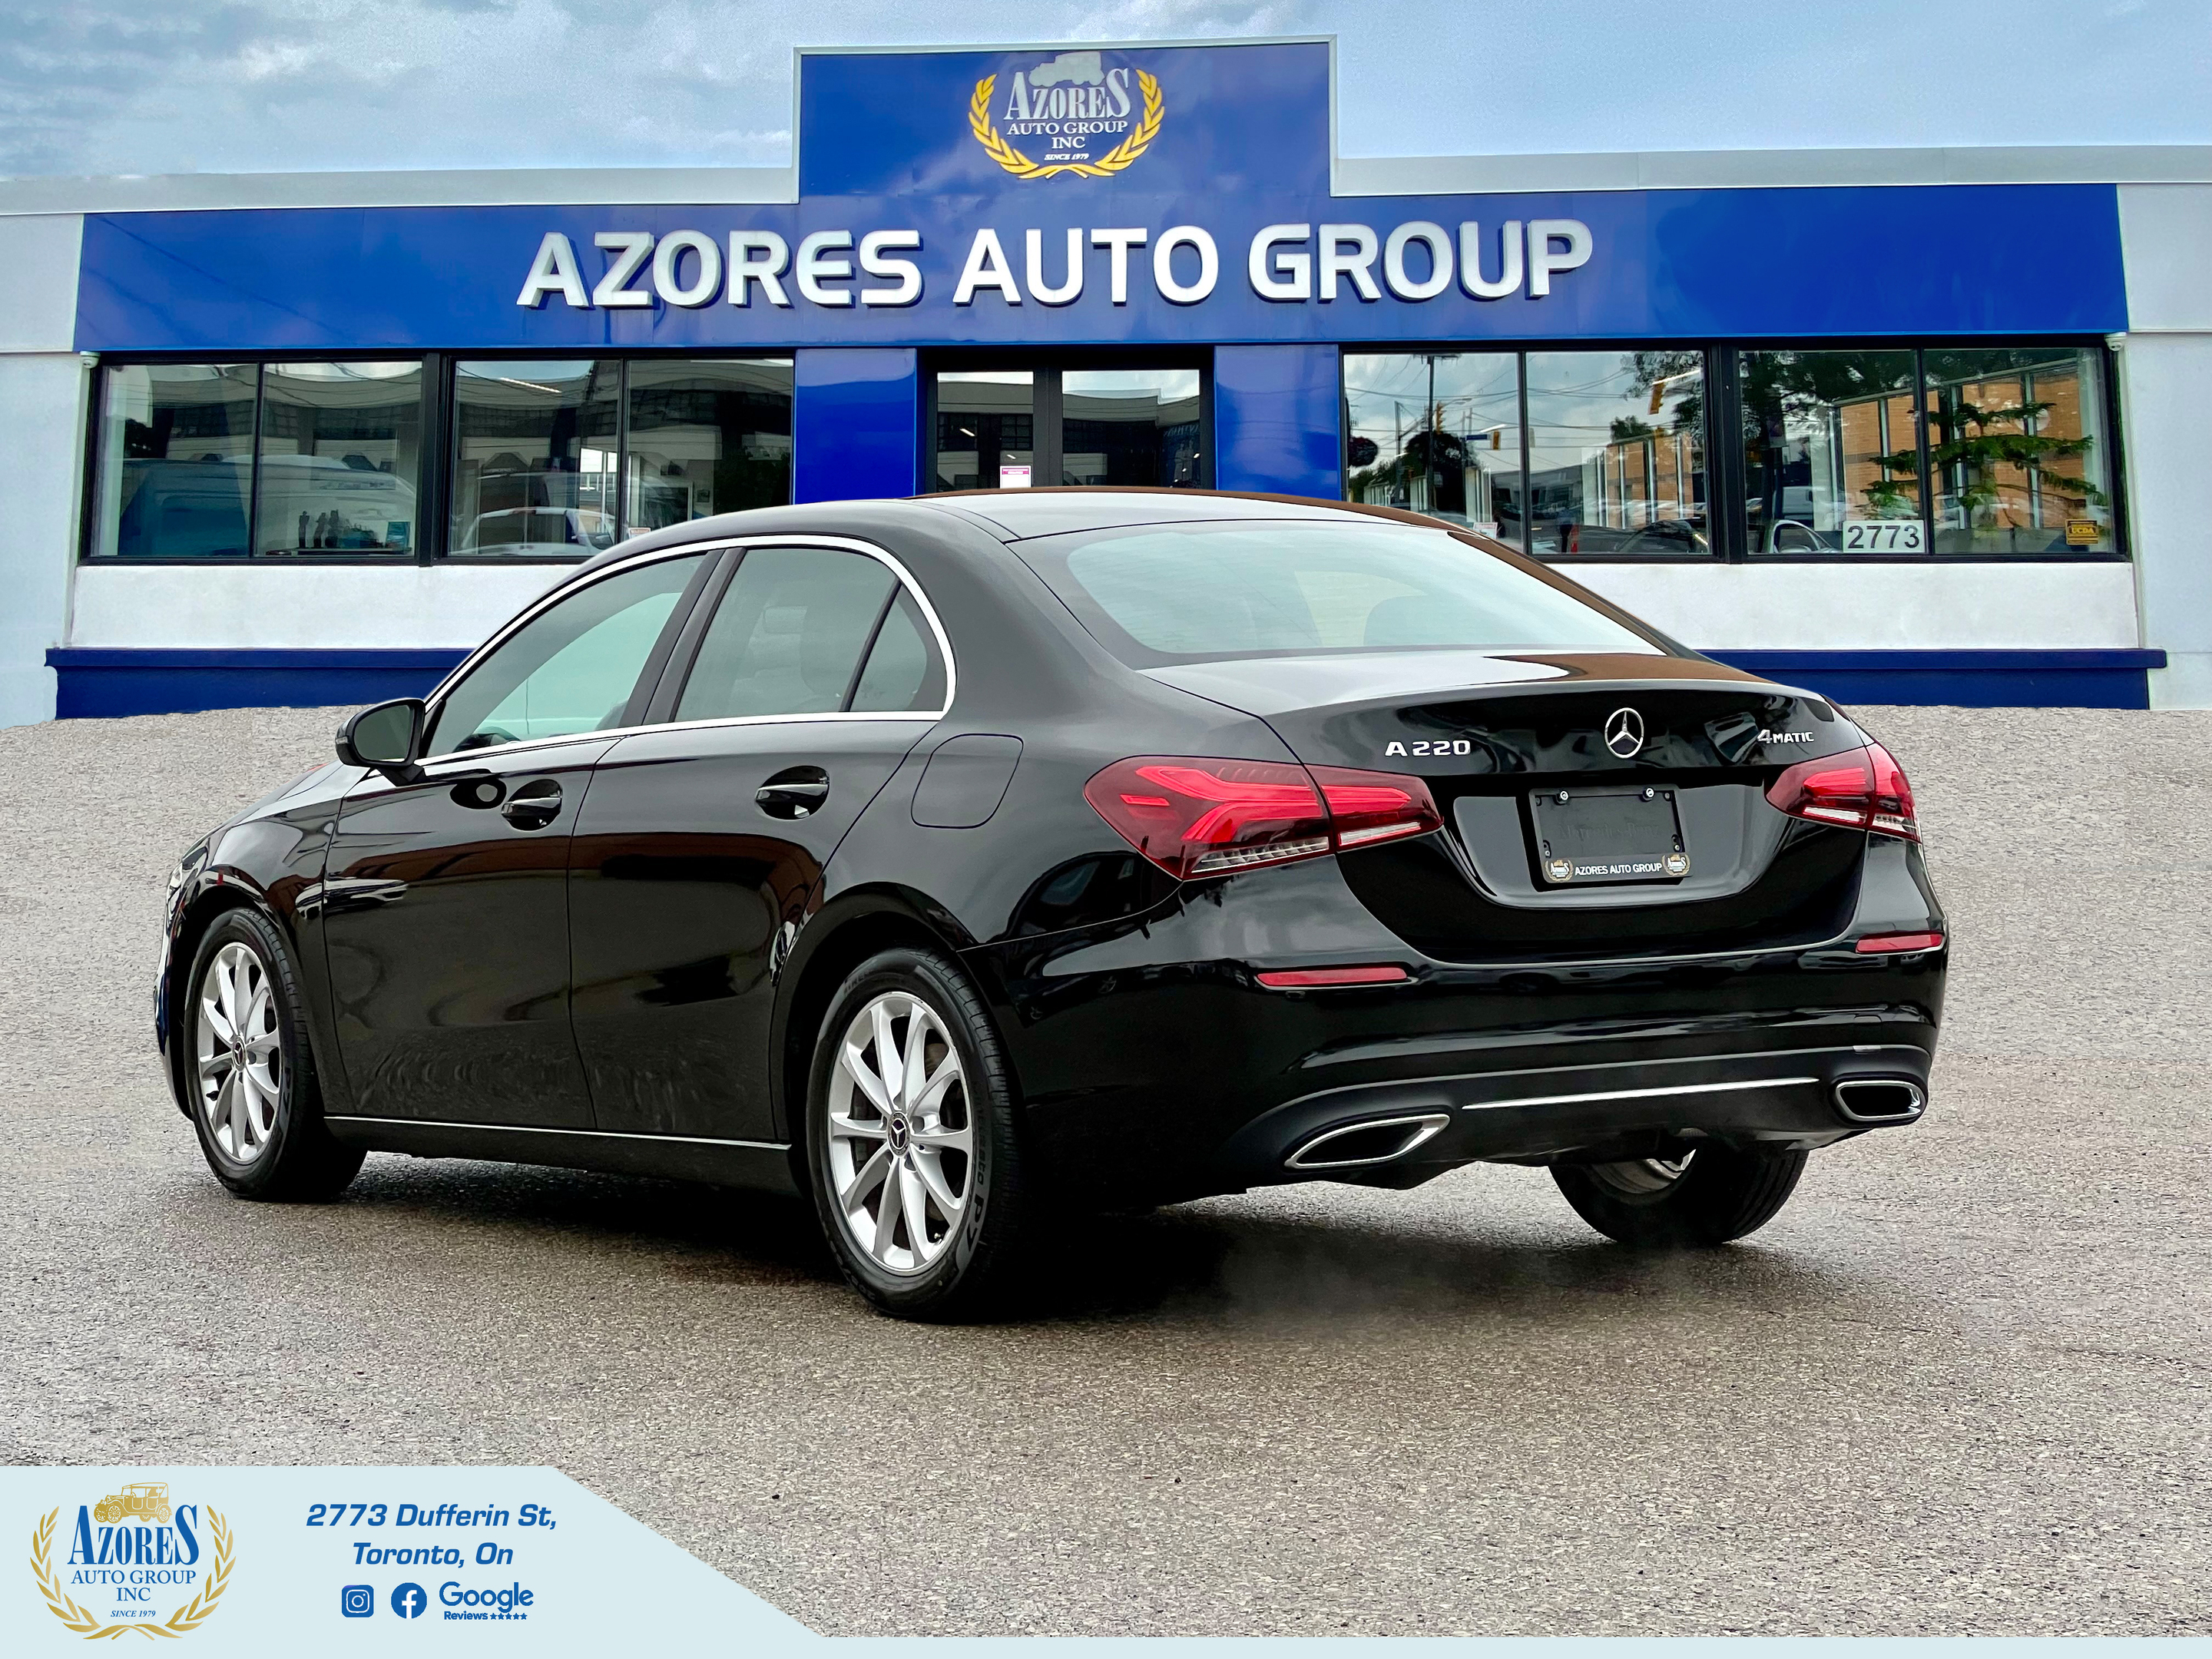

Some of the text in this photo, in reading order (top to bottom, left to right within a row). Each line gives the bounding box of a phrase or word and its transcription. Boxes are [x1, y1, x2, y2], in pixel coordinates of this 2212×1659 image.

[1003, 68, 1131, 121] AZORES
[1006, 121, 1128, 135] AUTO GROUP
[1051, 136, 1086, 149] INC
[516, 219, 1594, 308] AZORES AUTO GROUP
[1847, 525, 1920, 549] 2773
[1757, 729, 1815, 744] 4MATIC
[1384, 740, 1471, 757] A 220
[1575, 865, 1608, 876] AZORES
[1609, 863, 1631, 875] AUTO
[1632, 862, 1663, 873] GROUP
[966, 1194, 985, 1252] P7
